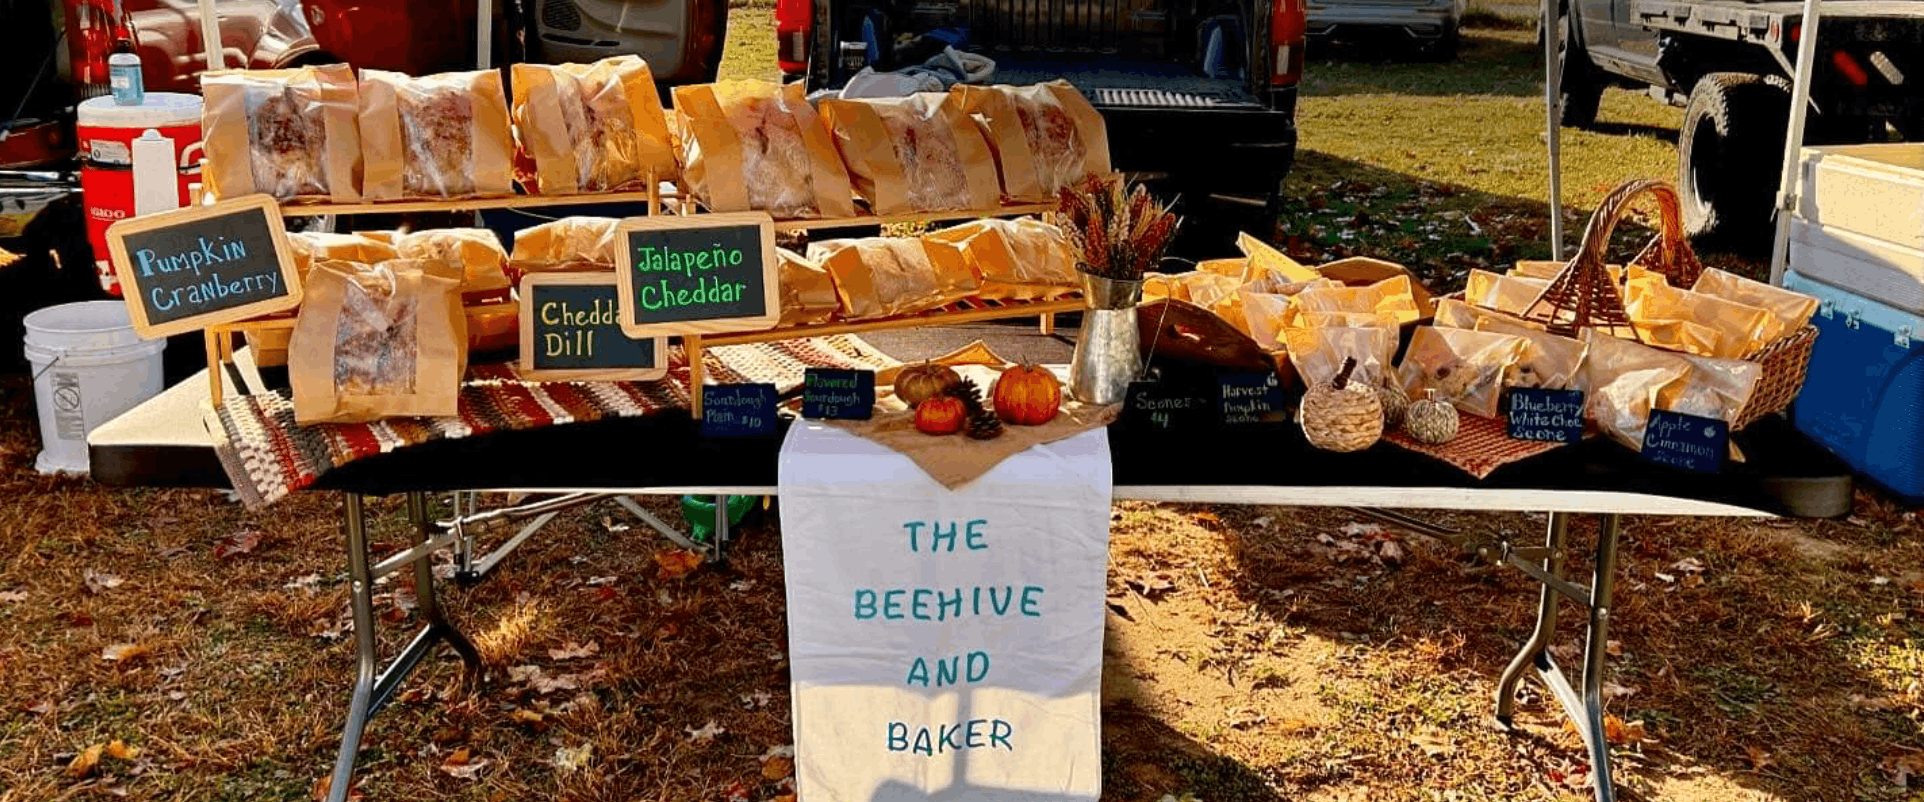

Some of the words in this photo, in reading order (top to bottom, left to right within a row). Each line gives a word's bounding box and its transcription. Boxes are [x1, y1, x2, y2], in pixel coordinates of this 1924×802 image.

[136, 236, 246, 277] Pumpkin
[637, 243, 743, 277] Jalapeño
[641, 275, 747, 310] Cheddar
[541, 299, 621, 326] Chedda
[544, 330, 594, 357] Dill
[1511, 392, 1584, 418] Blueberry
[1649, 413, 1692, 438] Apple
[903, 518, 988, 553] THE
[853, 586, 1045, 622] BEEHIVE
[906, 650, 991, 688] AND
[887, 718, 1014, 757] BAKER
